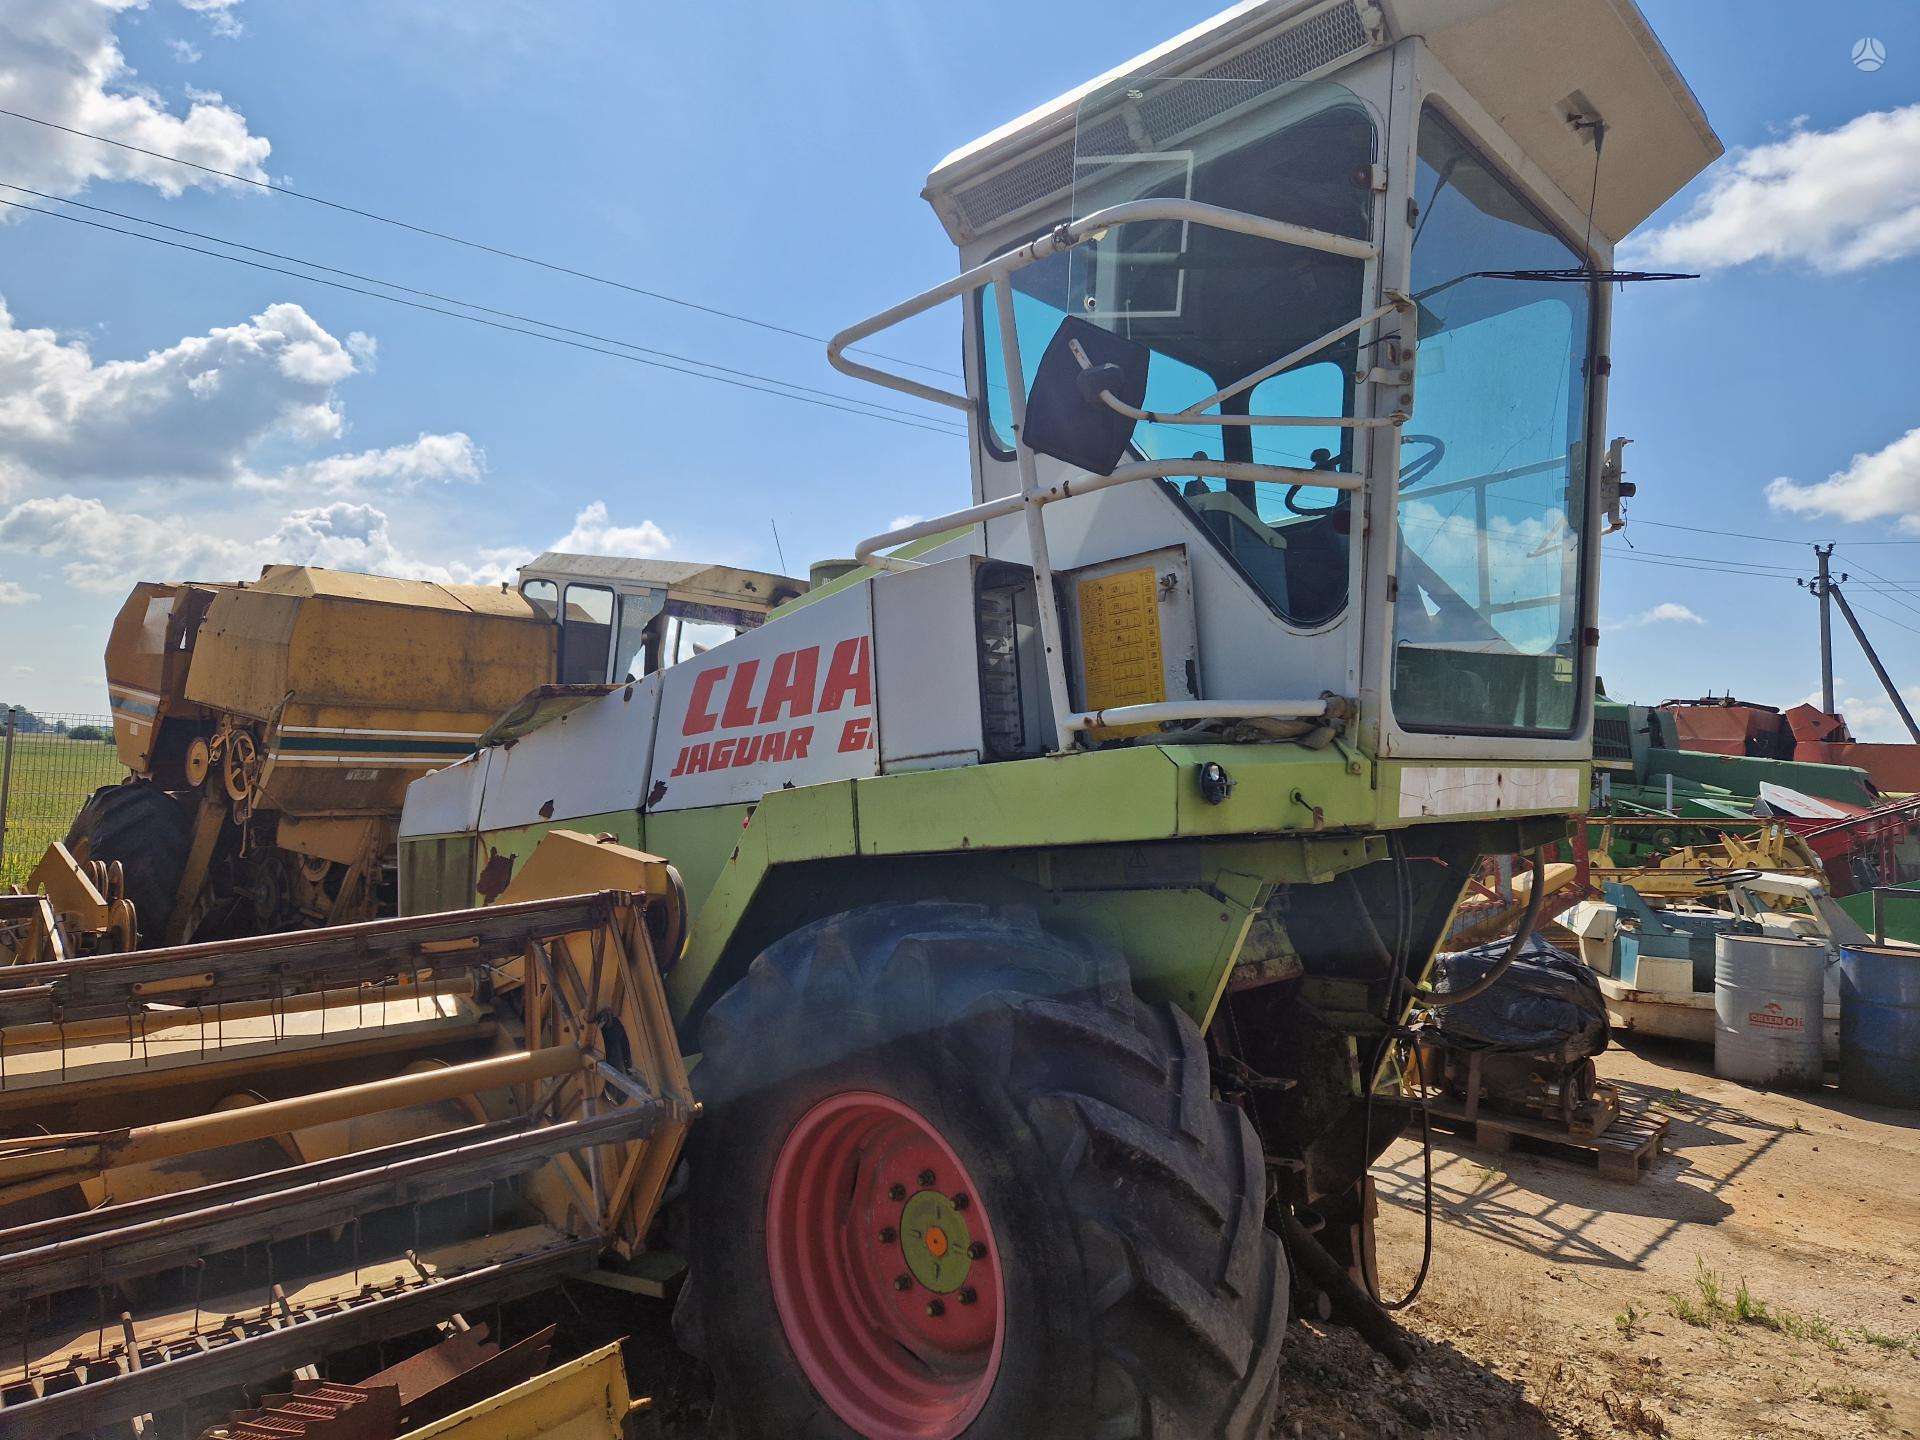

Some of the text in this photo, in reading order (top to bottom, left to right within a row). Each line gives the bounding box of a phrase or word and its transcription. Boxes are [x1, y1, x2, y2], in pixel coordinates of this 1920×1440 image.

[682, 635, 872, 737] CLAA
[670, 716, 874, 778] JAGUAR 6
